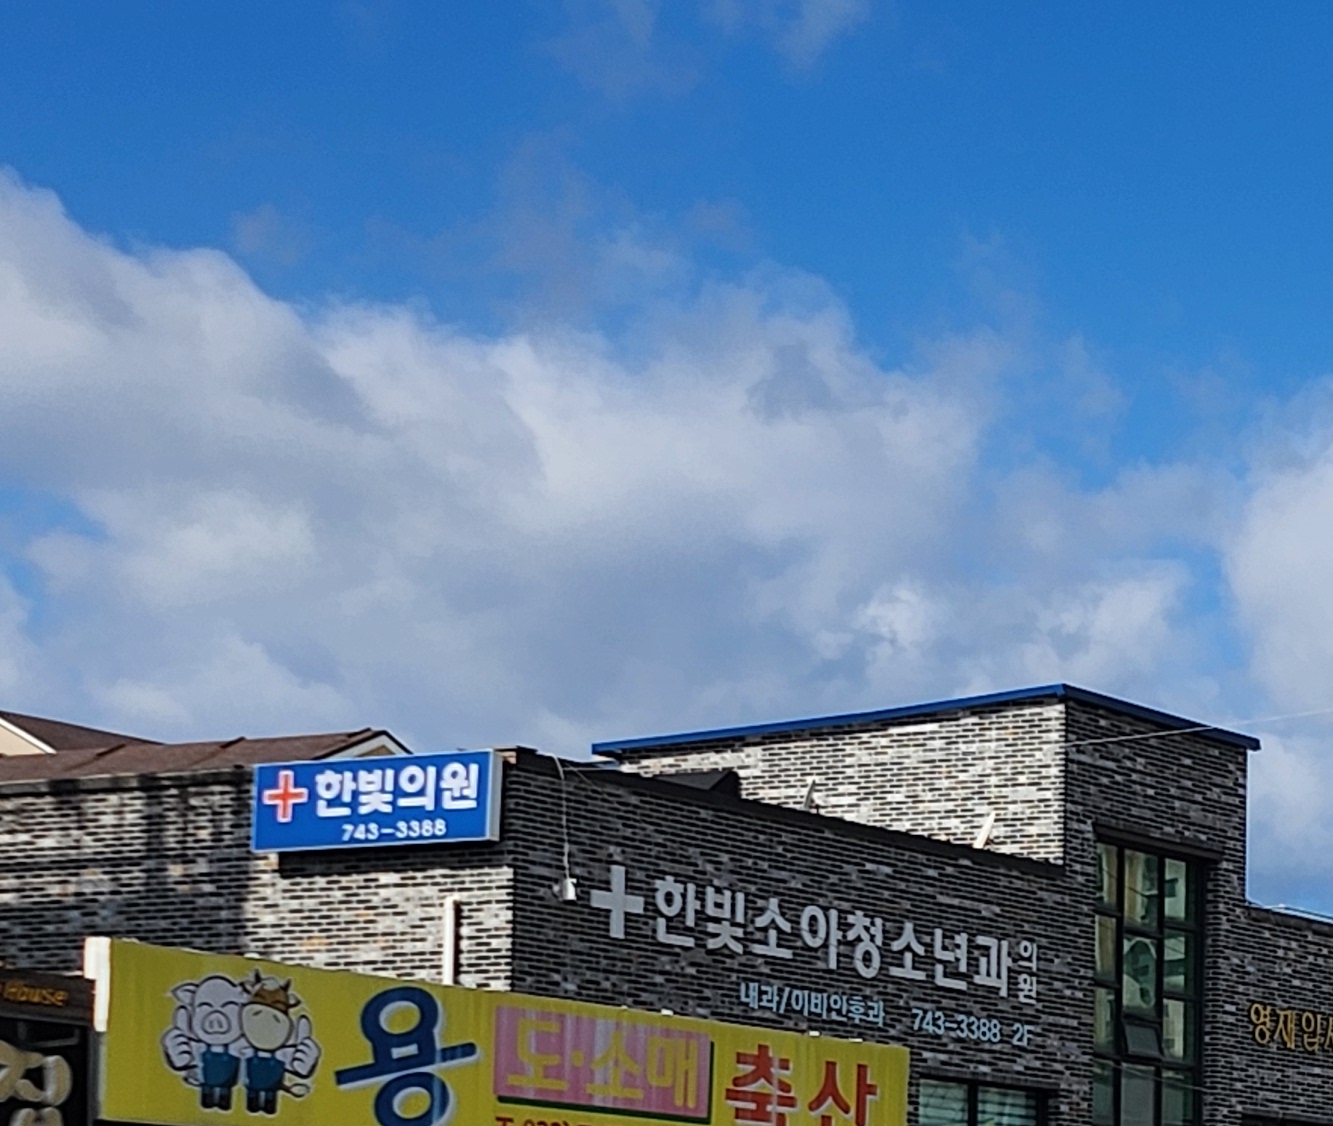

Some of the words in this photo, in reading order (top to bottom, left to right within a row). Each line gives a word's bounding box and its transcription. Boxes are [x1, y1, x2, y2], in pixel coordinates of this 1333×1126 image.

[314, 762, 480, 818] 한빛의원
[341, 818, 447, 842] 743-3388
[653, 875, 1012, 998] 한빛소아청소년과
[1016, 938, 1040, 1005] 의원
[740, 981, 886, 1028] 내과/이비인후과
[912, 1008, 1002, 1043] 743-3388
[1012, 1022, 1035, 1047] 2F
